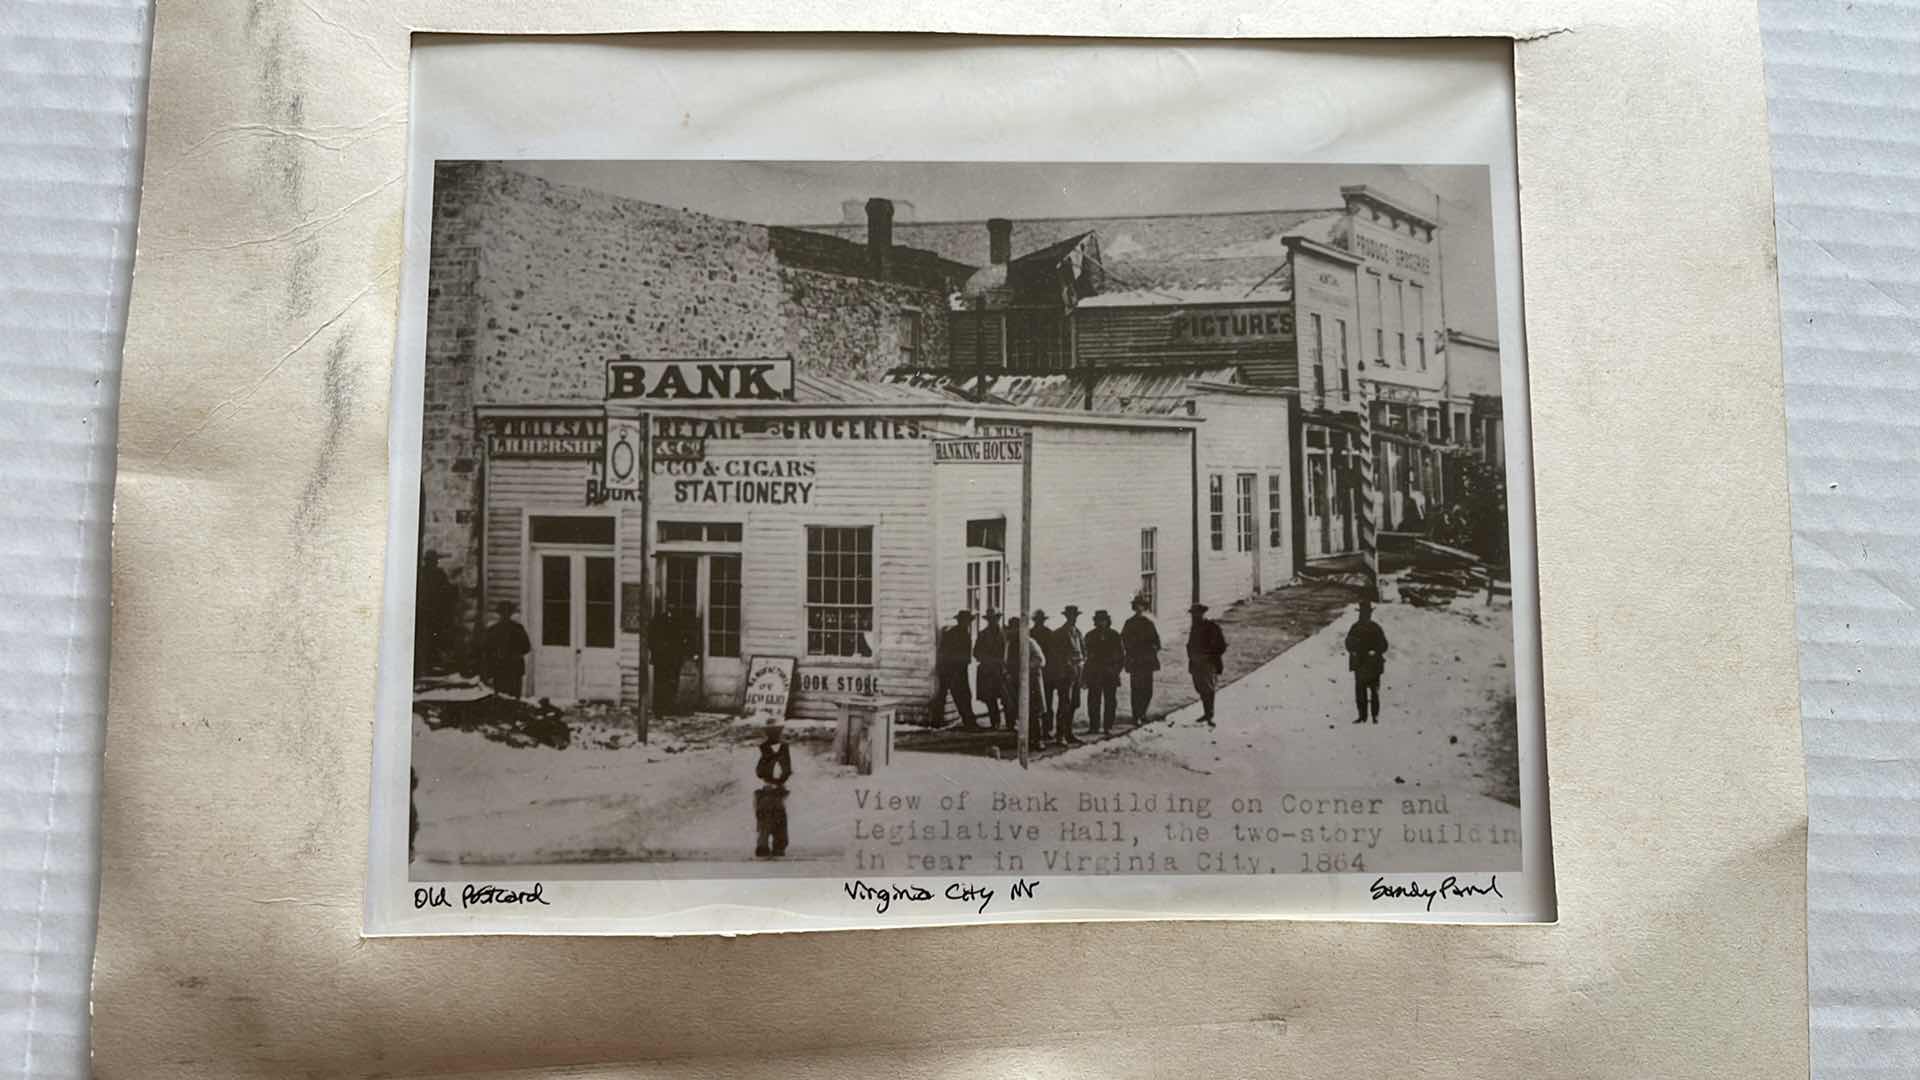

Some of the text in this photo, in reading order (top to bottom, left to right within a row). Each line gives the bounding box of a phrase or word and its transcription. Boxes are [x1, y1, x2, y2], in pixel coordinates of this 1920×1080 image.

[1175, 313, 1294, 337] PICTURES
[655, 420, 741, 439] RETAIL
[935, 441, 1022, 460] BANKING HOUSE
[725, 460, 817, 477] CIGARS
[674, 480, 814, 504] STATIONERY
[800, 675, 829, 690] OOK
[855, 789, 1450, 819] View of Bank Building on Corner and
[855, 819, 1522, 848] Legislative Hall, the two-story buildin
[855, 850, 885, 871] in
[906, 854, 973, 871] rear
[994, 851, 1024, 871] in
[1042, 850, 1180, 875] Virginia
[1301, 852, 1366, 873] 1864
[414, 882, 551, 909] Old Postcard
[844, 879, 935, 914] Virginia
[945, 882, 995, 914] City
